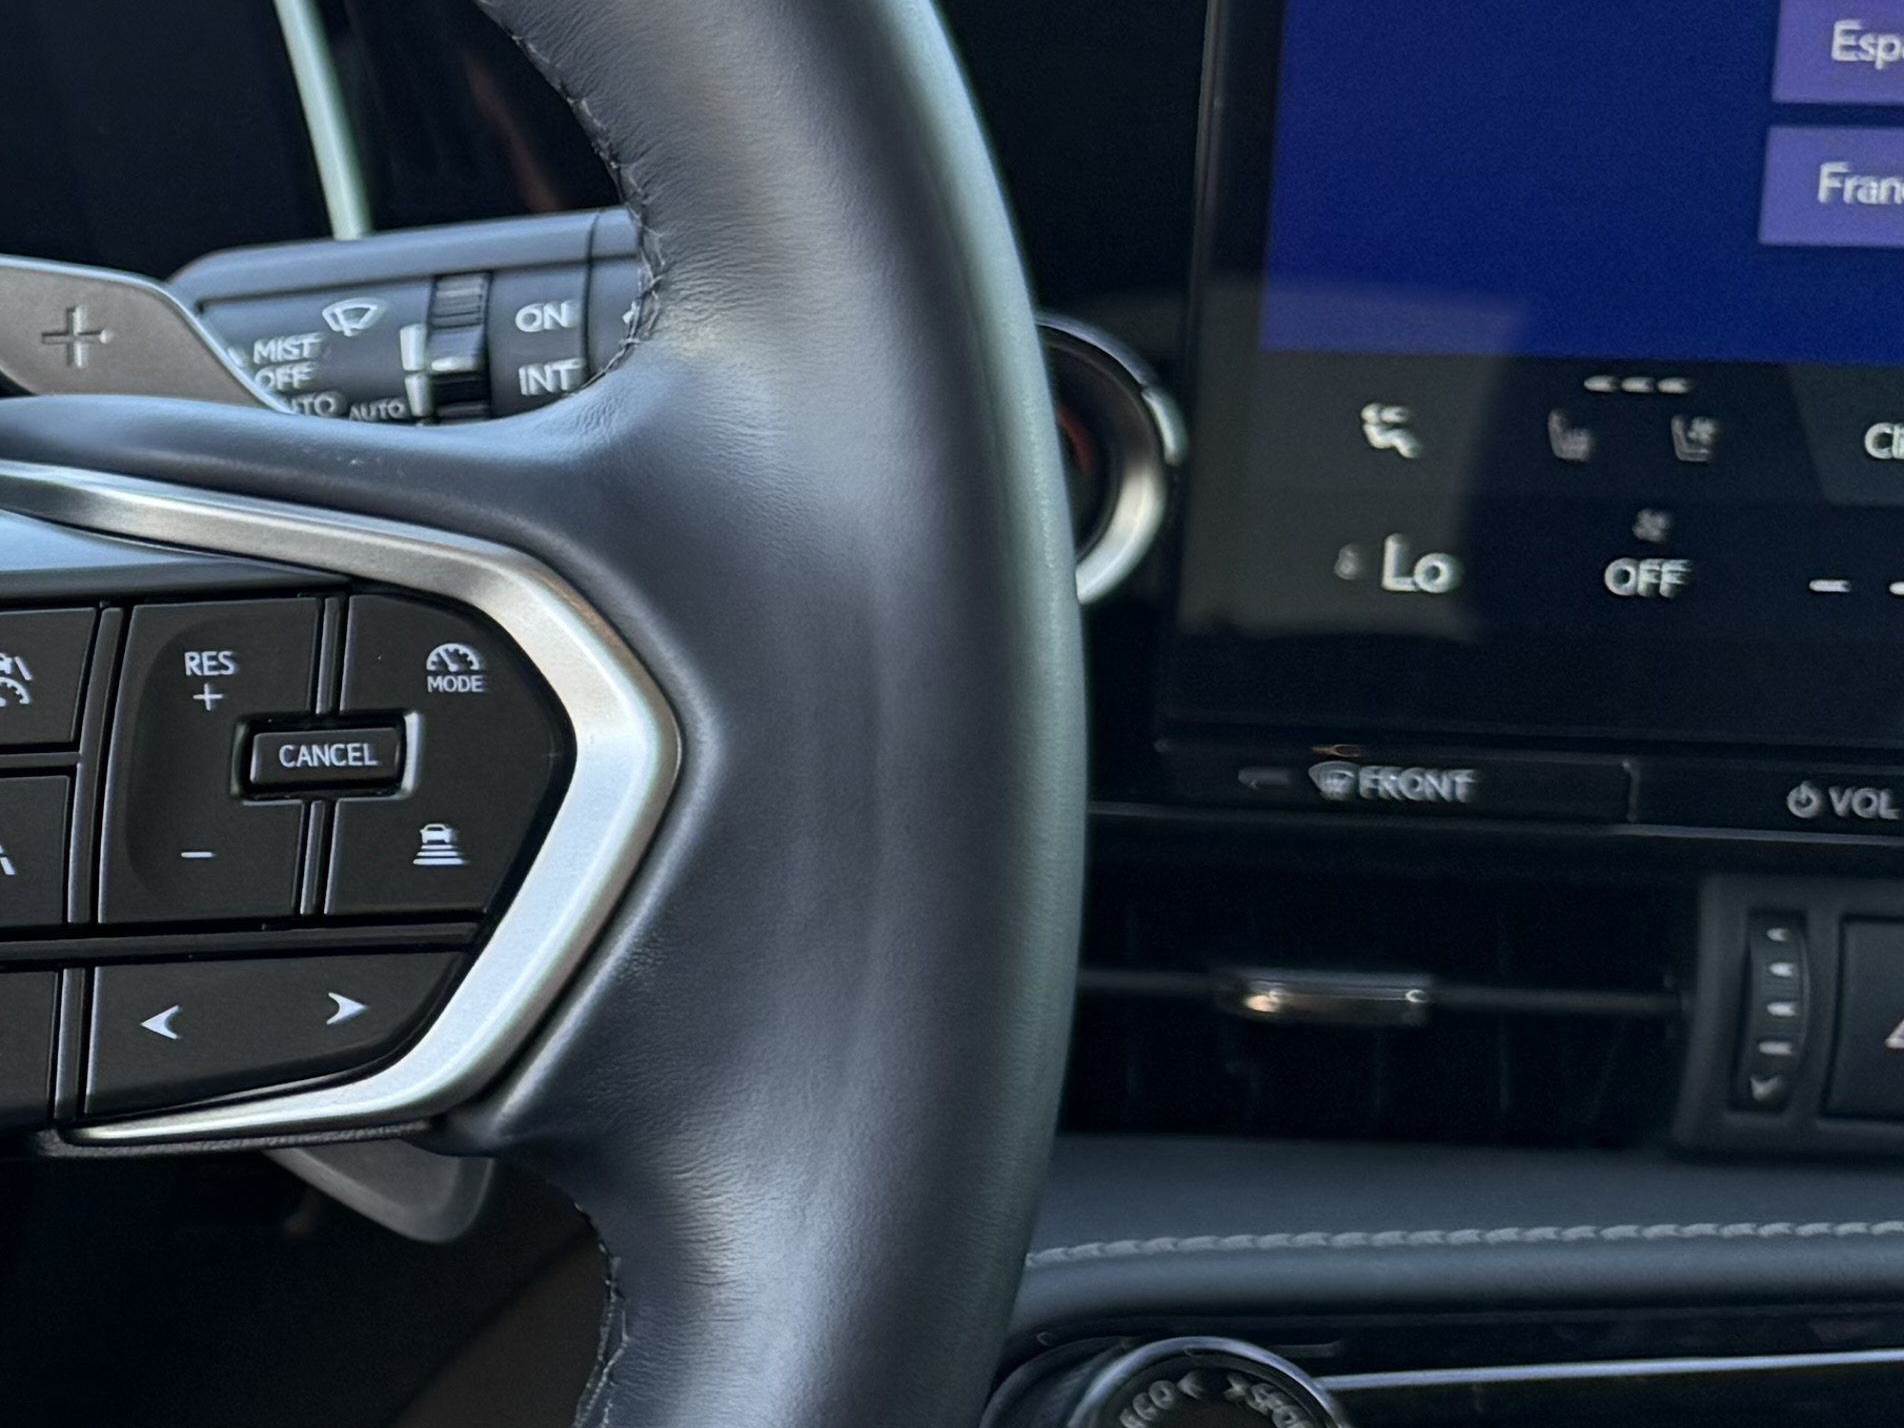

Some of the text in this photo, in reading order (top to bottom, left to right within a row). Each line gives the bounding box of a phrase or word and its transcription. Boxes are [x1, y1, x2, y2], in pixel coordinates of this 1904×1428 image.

[515, 301, 580, 332] ON
[252, 331, 325, 365] MIST
[254, 361, 320, 392] OFF
[518, 358, 585, 396] INT
[349, 397, 410, 421] AUTO
[1604, 558, 1692, 598] OFF
[184, 650, 236, 677] RES
[426, 675, 484, 693] MODE
[278, 742, 378, 769] CANCEL
[1359, 766, 1480, 805] FRONT
[1828, 786, 1900, 820] VOL
